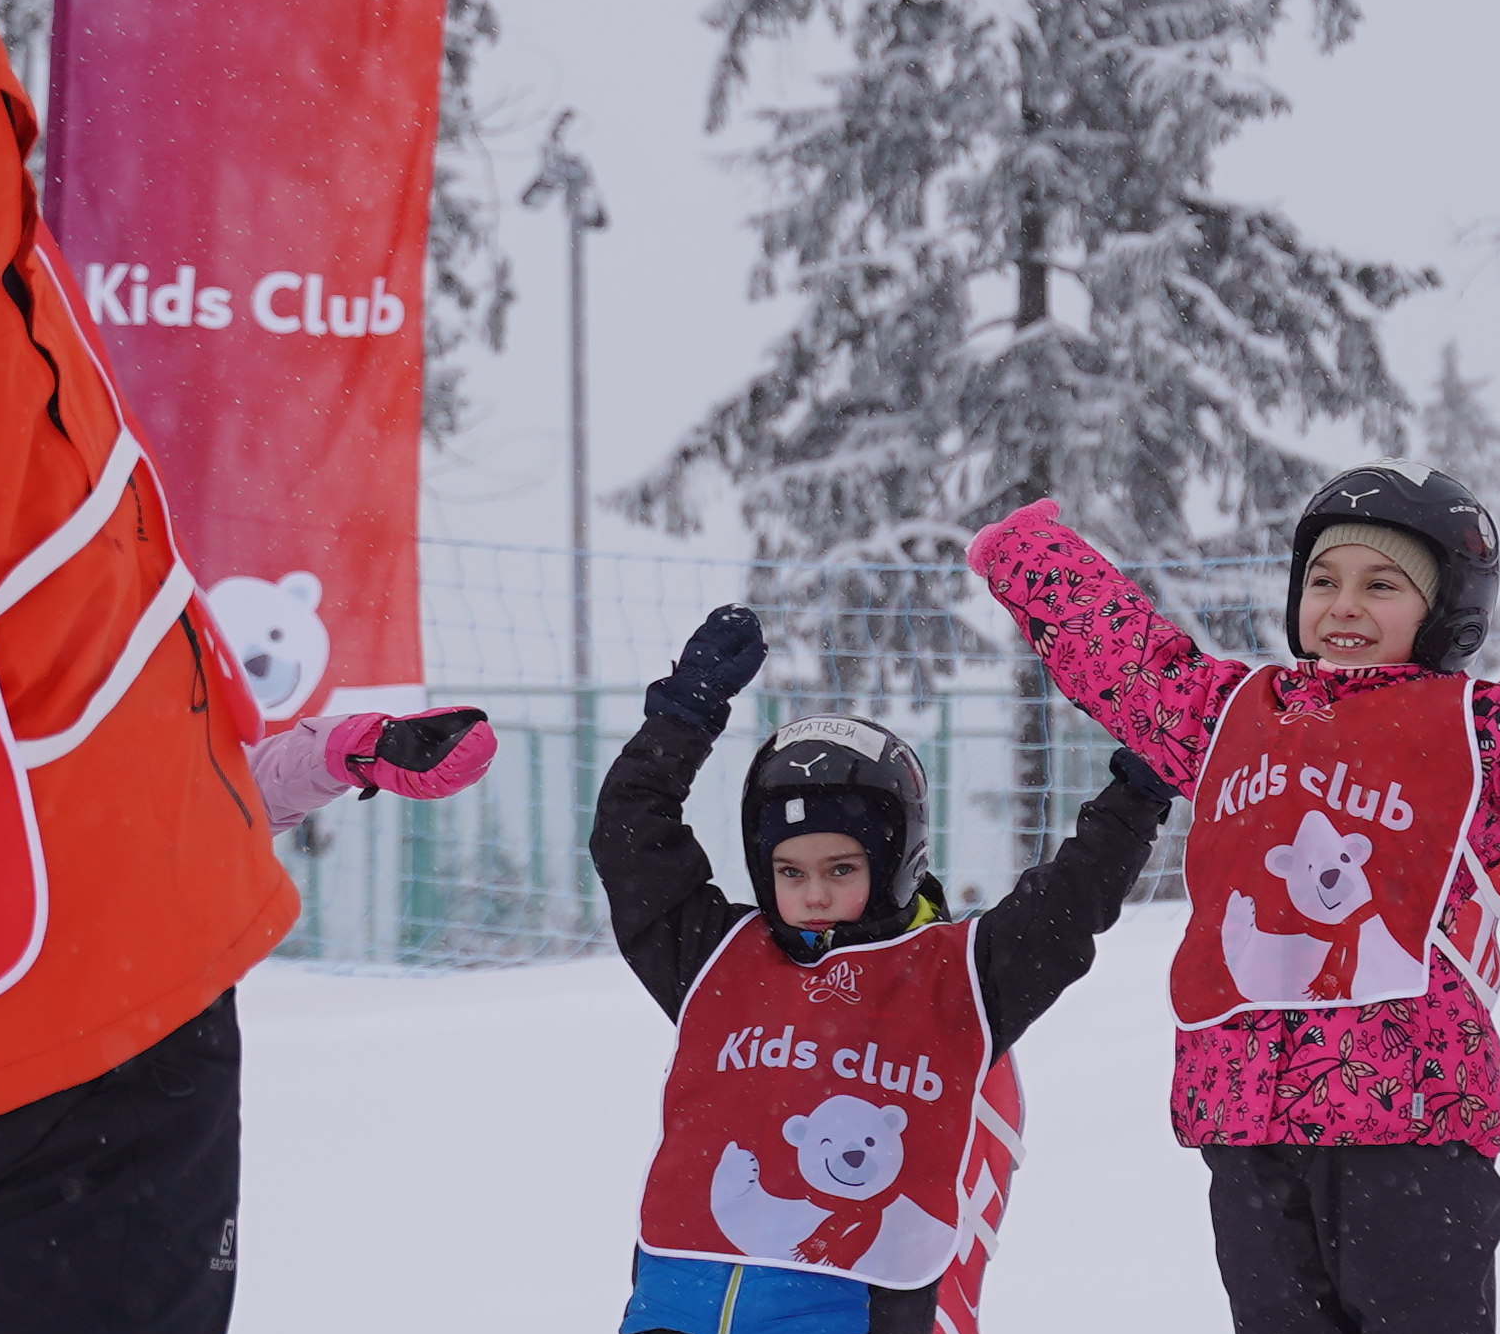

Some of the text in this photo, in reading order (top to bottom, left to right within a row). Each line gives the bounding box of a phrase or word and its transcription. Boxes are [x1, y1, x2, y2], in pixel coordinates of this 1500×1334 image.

[83, 262, 406, 337] Kids Club
[1213, 753, 1414, 831] Kids club
[716, 1025, 944, 1101] Kids club
